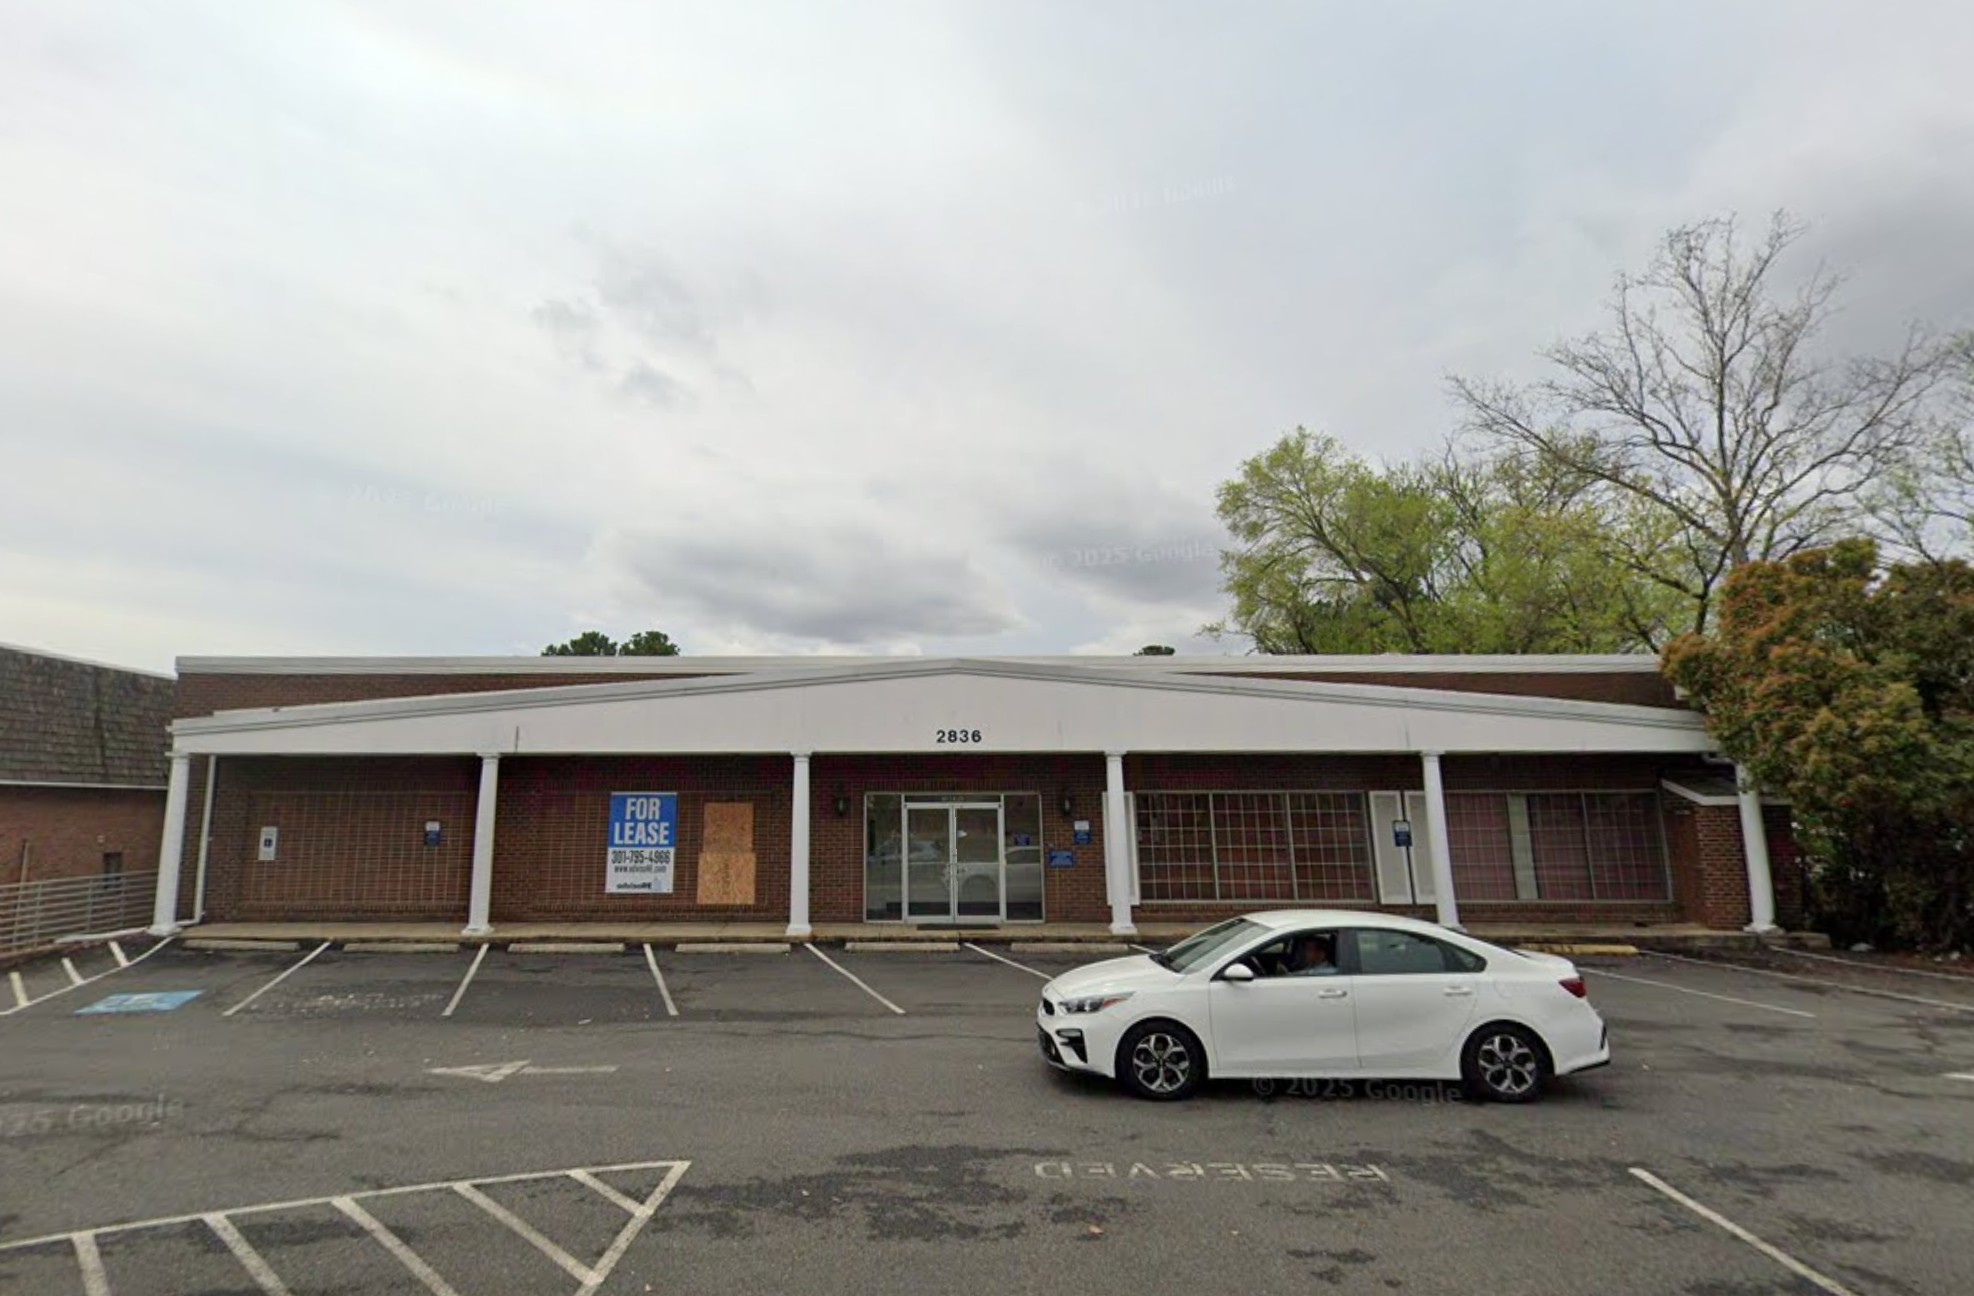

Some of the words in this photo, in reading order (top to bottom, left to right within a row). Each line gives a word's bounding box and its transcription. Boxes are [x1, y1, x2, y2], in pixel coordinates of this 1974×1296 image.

[936, 730, 982, 743] 2836
[626, 798, 660, 819] FOR
[614, 823, 669, 844] LEASE
[1033, 1160, 1392, 1184] RESERVED
